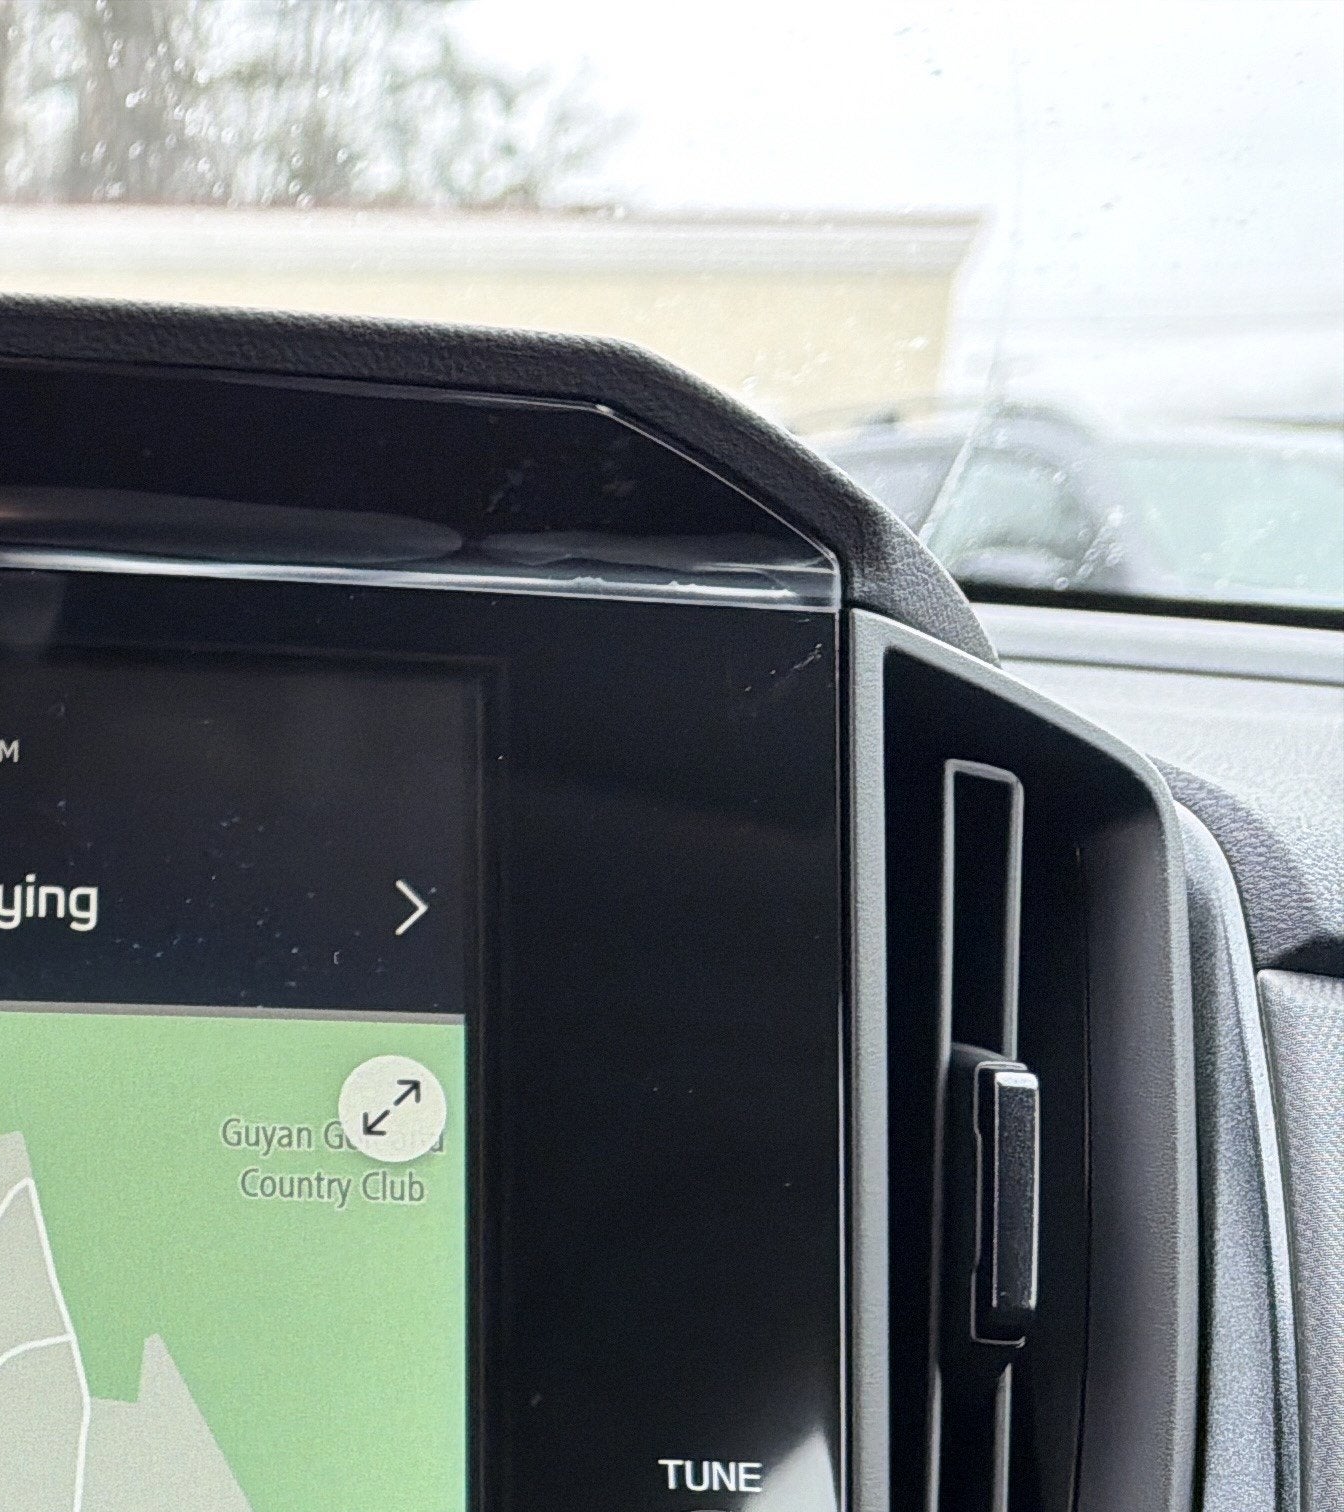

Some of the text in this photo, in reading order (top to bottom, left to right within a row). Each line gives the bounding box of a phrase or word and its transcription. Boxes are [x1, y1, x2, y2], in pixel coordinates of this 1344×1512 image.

[222, 1118, 312, 1156] Guyan
[240, 1168, 425, 1208] Country Club
[658, 1459, 762, 1492] TUNE
